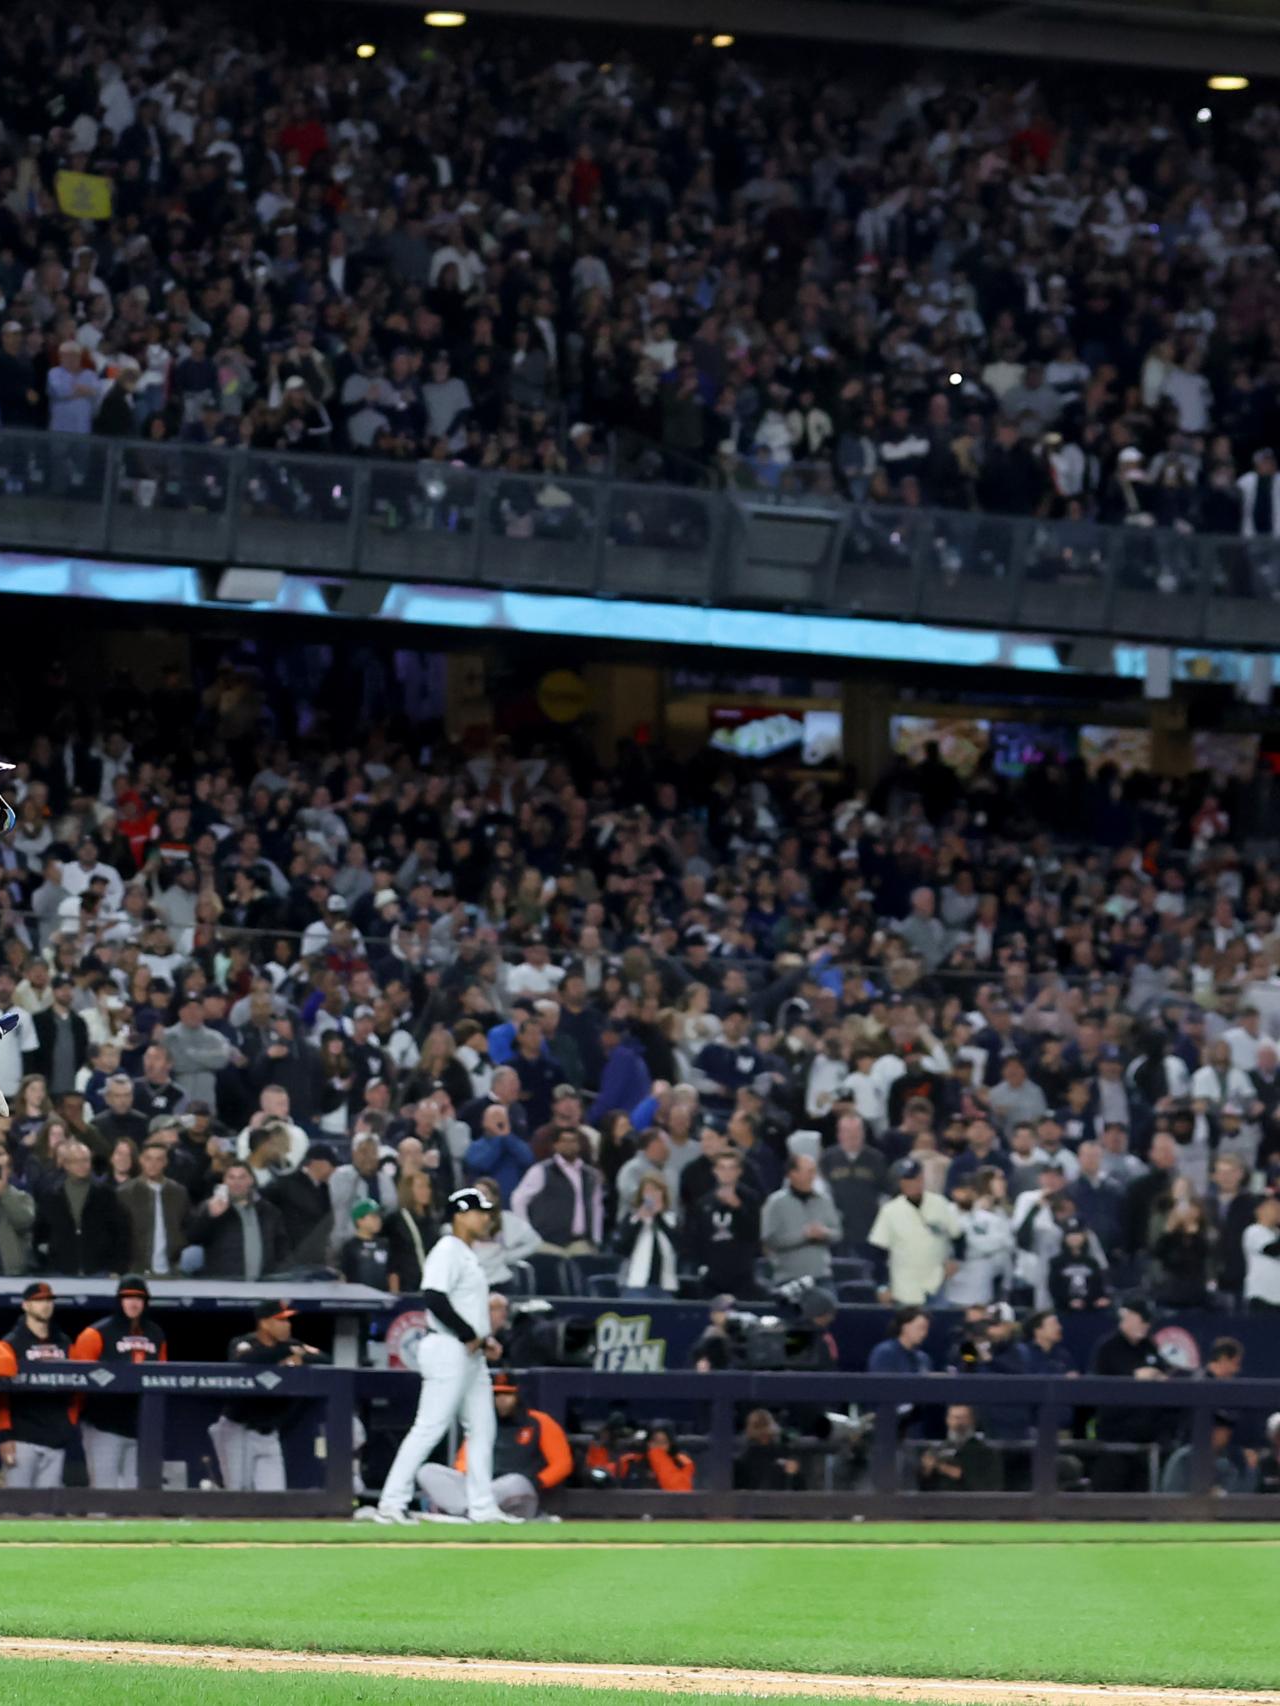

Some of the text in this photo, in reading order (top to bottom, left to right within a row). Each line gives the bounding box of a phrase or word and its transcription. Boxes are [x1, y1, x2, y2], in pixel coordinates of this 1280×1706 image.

[597, 1317, 645, 1350] OXI
[141, 1375, 177, 1388] BANK
[198, 1376, 255, 1390] AMERICA
